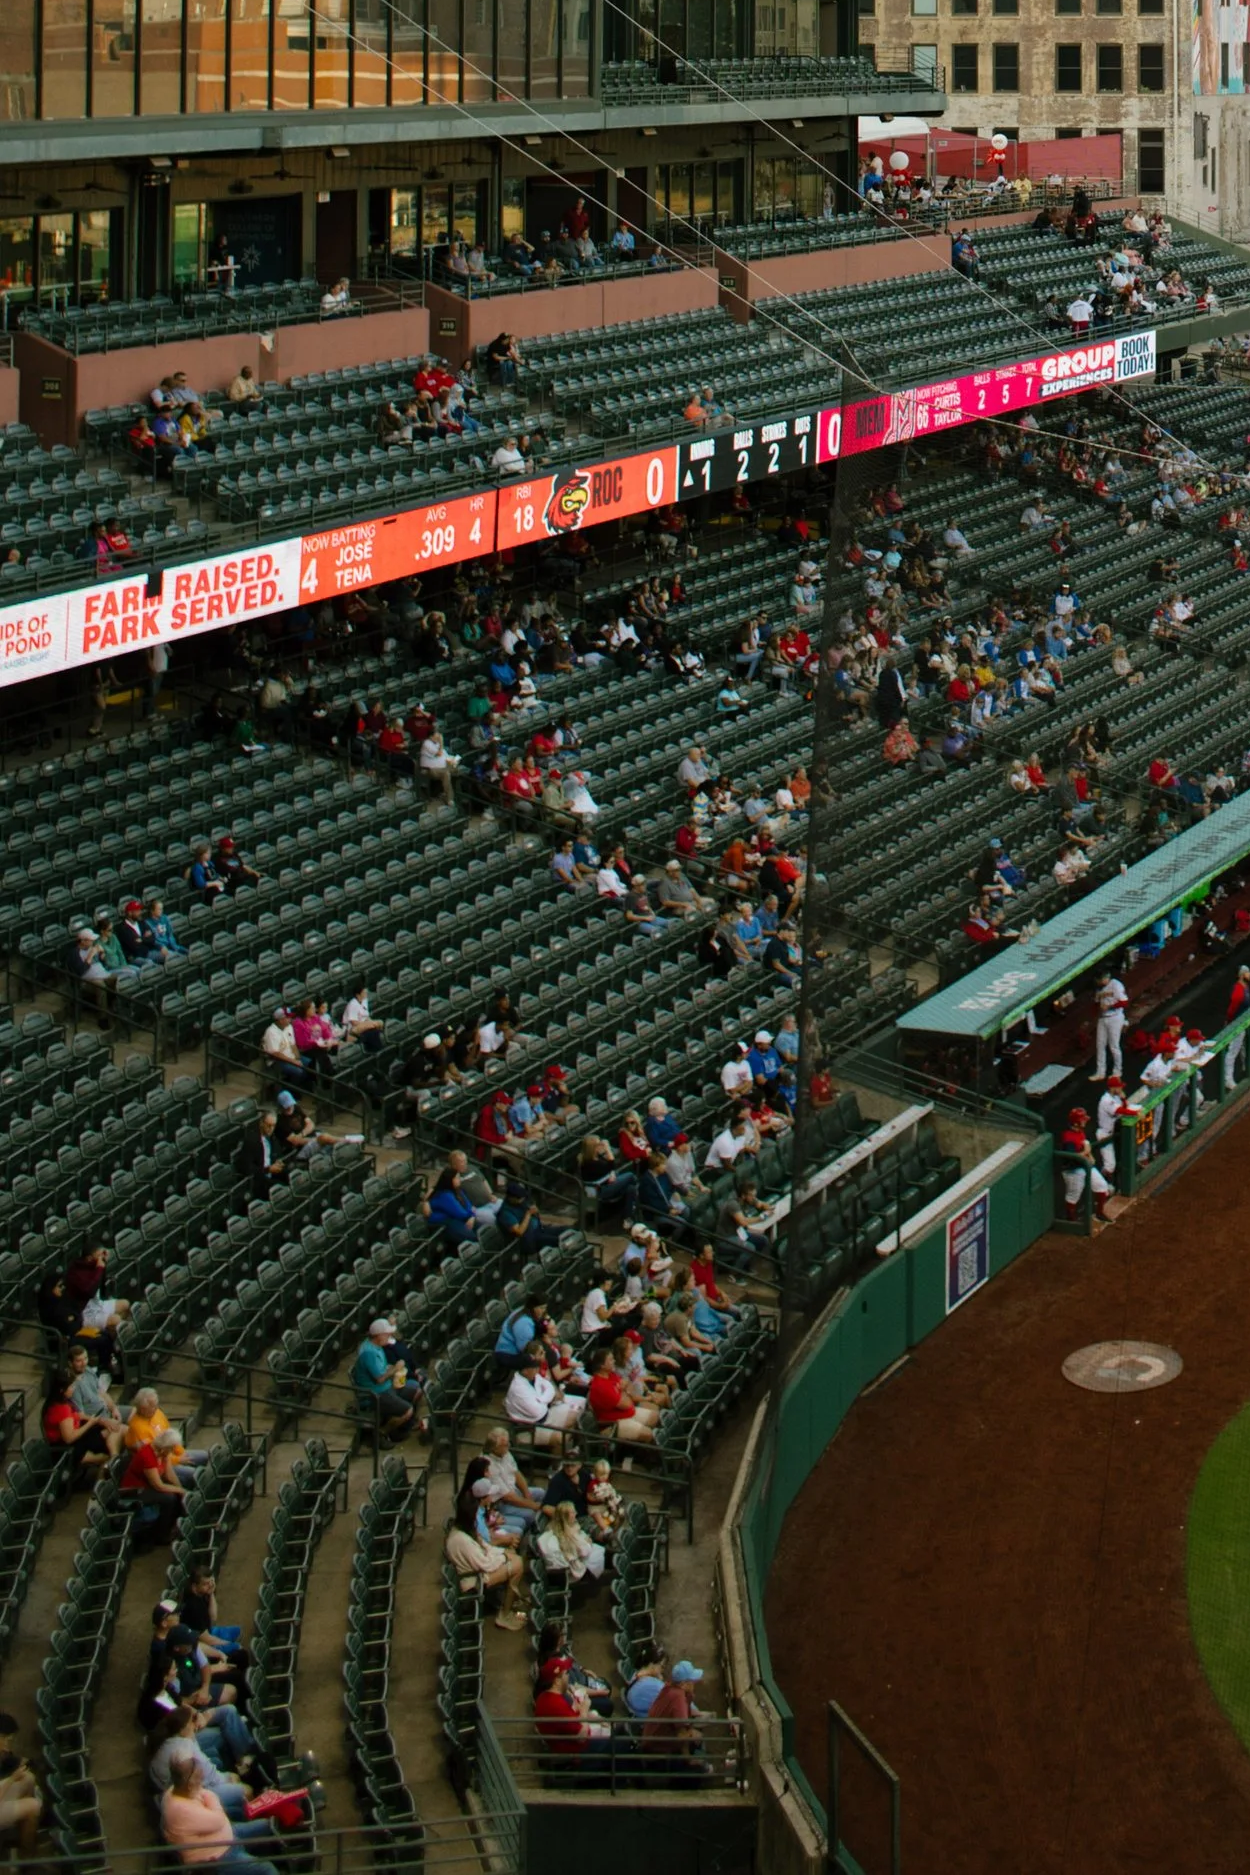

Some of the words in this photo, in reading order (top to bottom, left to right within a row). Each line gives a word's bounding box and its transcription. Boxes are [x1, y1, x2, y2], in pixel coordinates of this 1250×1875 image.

[1121, 335, 1149, 359] BOOK
[974, 373, 991, 386] BALLS
[1021, 362, 1037, 373] TOTAL
[1041, 344, 1114, 381] GROUP
[1117, 352, 1154, 378] TODAY!
[977, 389, 986, 410] 2
[1002, 384, 1010, 404] 5
[1025, 377, 1033, 397] 7
[1041, 367, 1113, 396] EXPERIENCES
[934, 392, 961, 411] CURTIS
[855, 403, 885, 439] MEM
[917, 405, 929, 430] 66
[934, 408, 962, 426] TAYLOR
[828, 413, 842, 456] 0
[701, 459, 711, 491] 1
[736, 450, 749, 482] 2
[768, 442, 780, 473] 2
[798, 435, 807, 465] 1
[515, 485, 532, 500] RBI
[592, 466, 622, 508] ROC
[646, 457, 664, 505] 0
[426, 506, 447, 523] AVG
[469, 497, 484, 511] HR
[469, 517, 481, 544] 4
[514, 504, 534, 533] 18
[303, 535, 329, 554] NOW
[331, 524, 376, 547] BATTING
[335, 537, 373, 566] JOSÉ
[415, 525, 455, 560] .309
[175, 554, 280, 601] RAISED.
[301, 558, 318, 594] 4
[335, 563, 372, 589] TENA
[28, 613, 48, 633] OF
[83, 609, 160, 653] PARK
[171, 580, 284, 630] SERVED.
[5, 632, 52, 657] POND
[1065, 916, 1109, 938] one
[1022, 938, 1075, 965] app.
